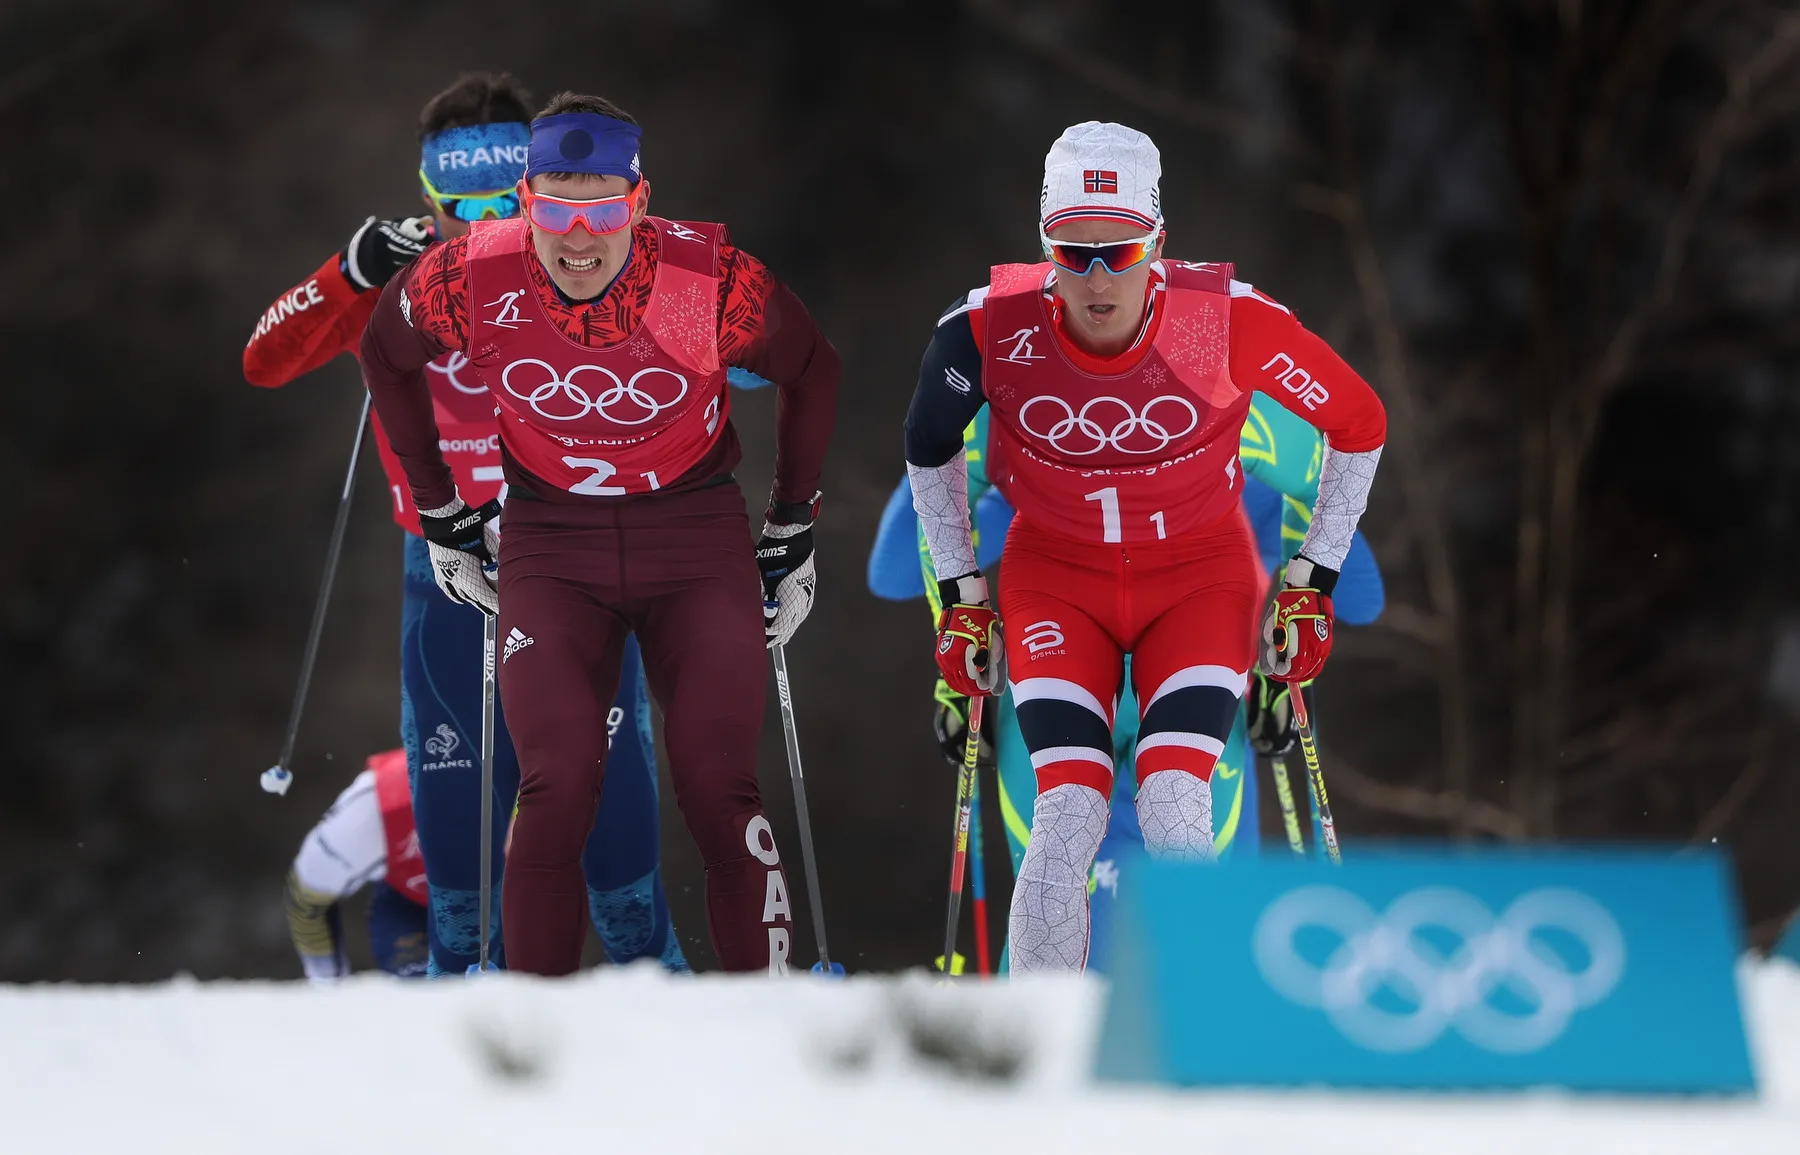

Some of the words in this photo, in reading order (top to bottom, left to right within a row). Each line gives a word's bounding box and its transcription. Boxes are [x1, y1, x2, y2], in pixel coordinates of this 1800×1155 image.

[438, 145, 528, 171] FRANC
[247, 279, 324, 347] RANCE
[1261, 352, 1330, 411] NOR
[439, 433, 500, 456] eongC
[561, 456, 626, 496] 2
[640, 471, 661, 491] 1
[452, 511, 481, 533] SWIX
[1085, 487, 1122, 543] 1
[1150, 511, 1167, 540] 1
[755, 545, 788, 559] SWIX
[1279, 596, 1309, 624] LEKI
[958, 614, 987, 642] LEKI
[486, 639, 496, 682] SWIX
[502, 637, 534, 664] adidas
[775, 668, 790, 711] SWIX
[422, 760, 472, 772] FRANCE
[745, 814, 792, 979] OAR
